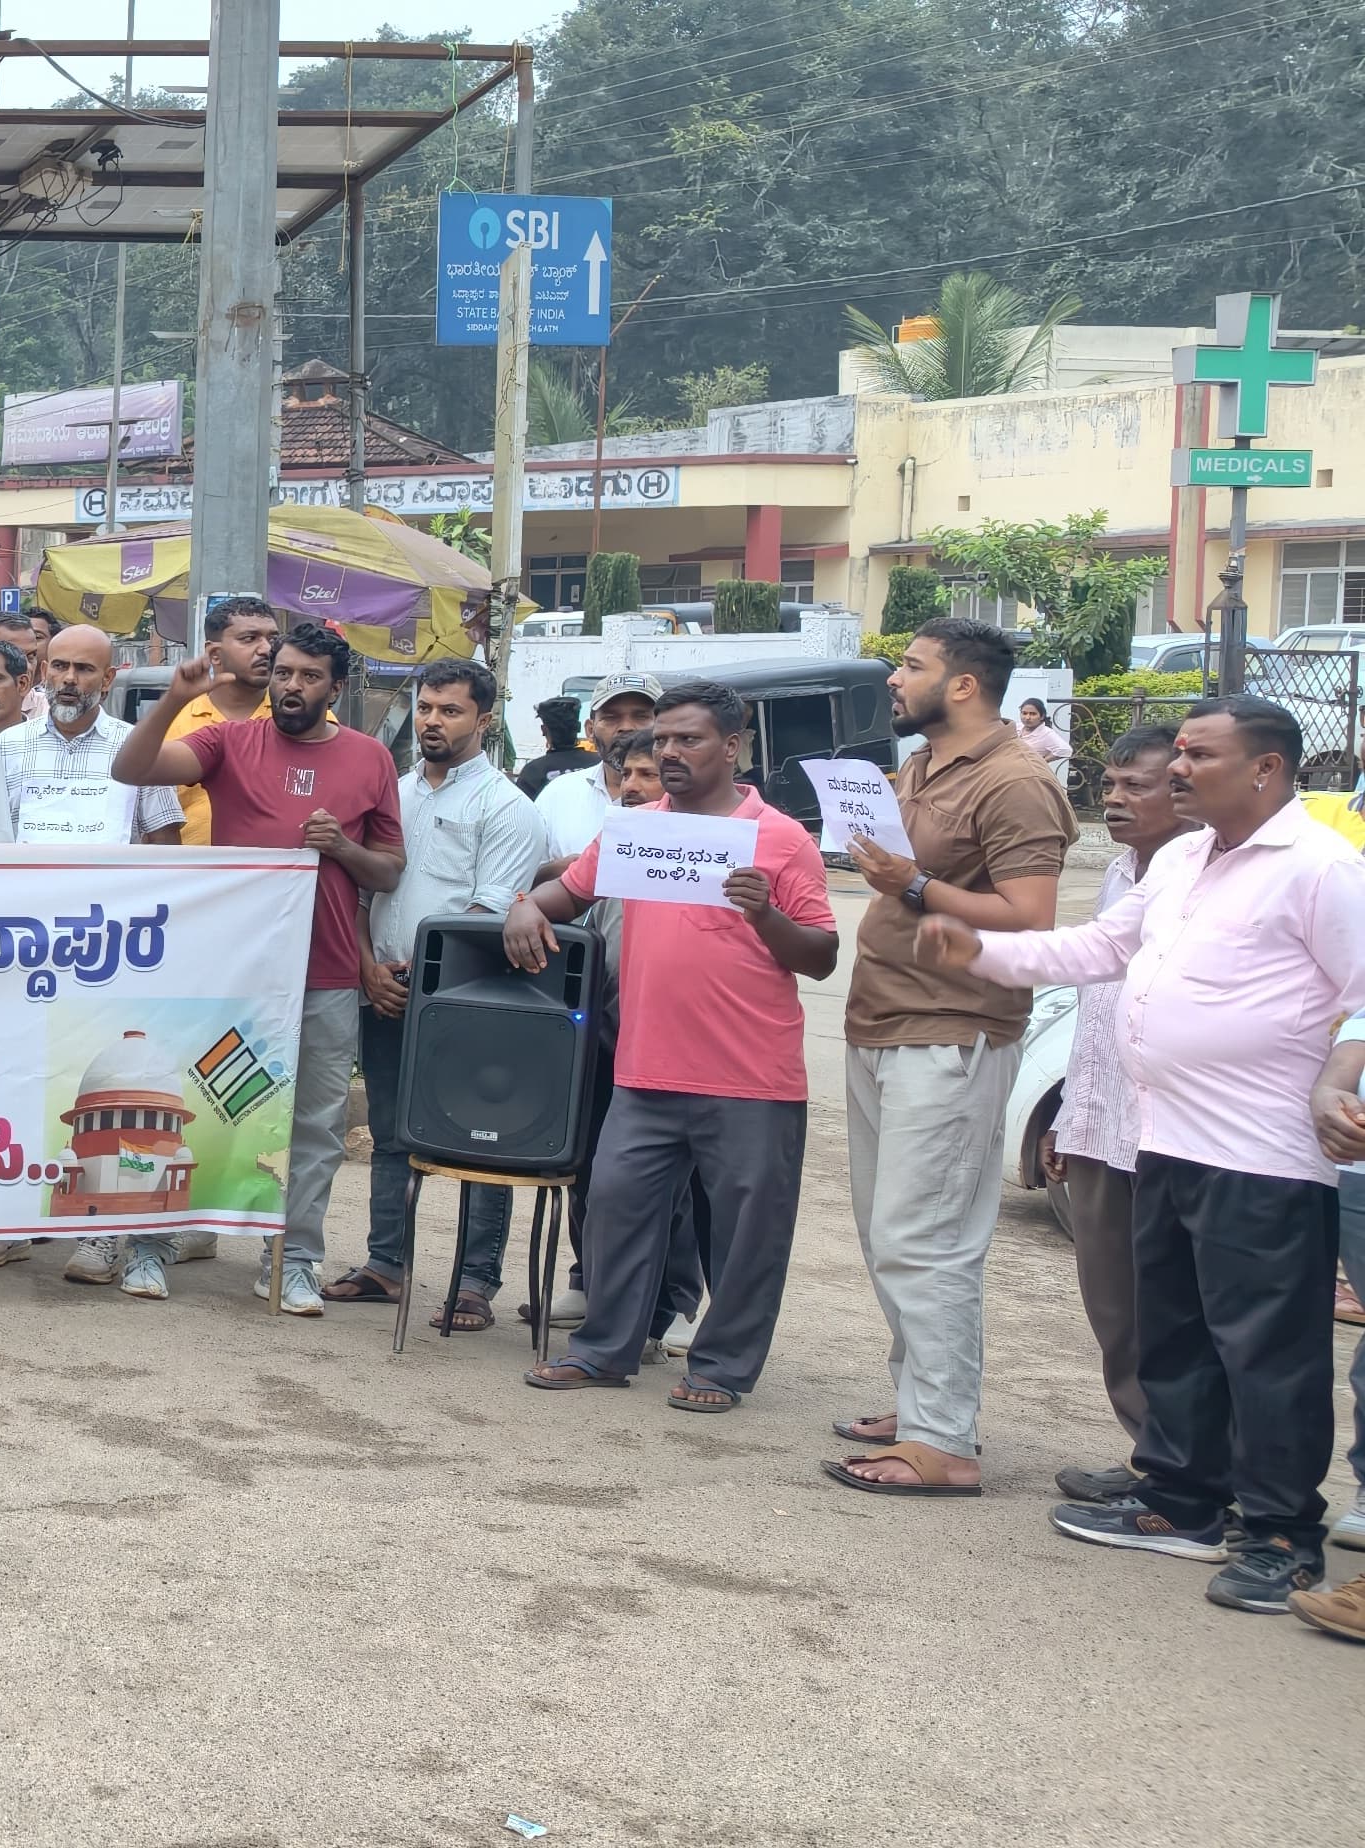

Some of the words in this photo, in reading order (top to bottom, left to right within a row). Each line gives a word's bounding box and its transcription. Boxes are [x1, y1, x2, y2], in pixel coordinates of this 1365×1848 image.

[505, 209, 559, 250] SBI
[456, 307, 487, 319] STATE
[489, 308, 500, 319] BA
[537, 308, 565, 320] INDIA
[1196, 457, 1306, 473] MEDICALS
[303, 584, 338, 601] Skei
[4, 591, 13, 612] P
[70, 786, 109, 796] ಕುಮಾರ್
[827, 776, 882, 795] ಮತದಾನದ
[616, 842, 736, 869] ಪ್ರಜಾಪ್ರಭುತ್ವ
[646, 866, 701, 883] ಉಳಿಸಿ
